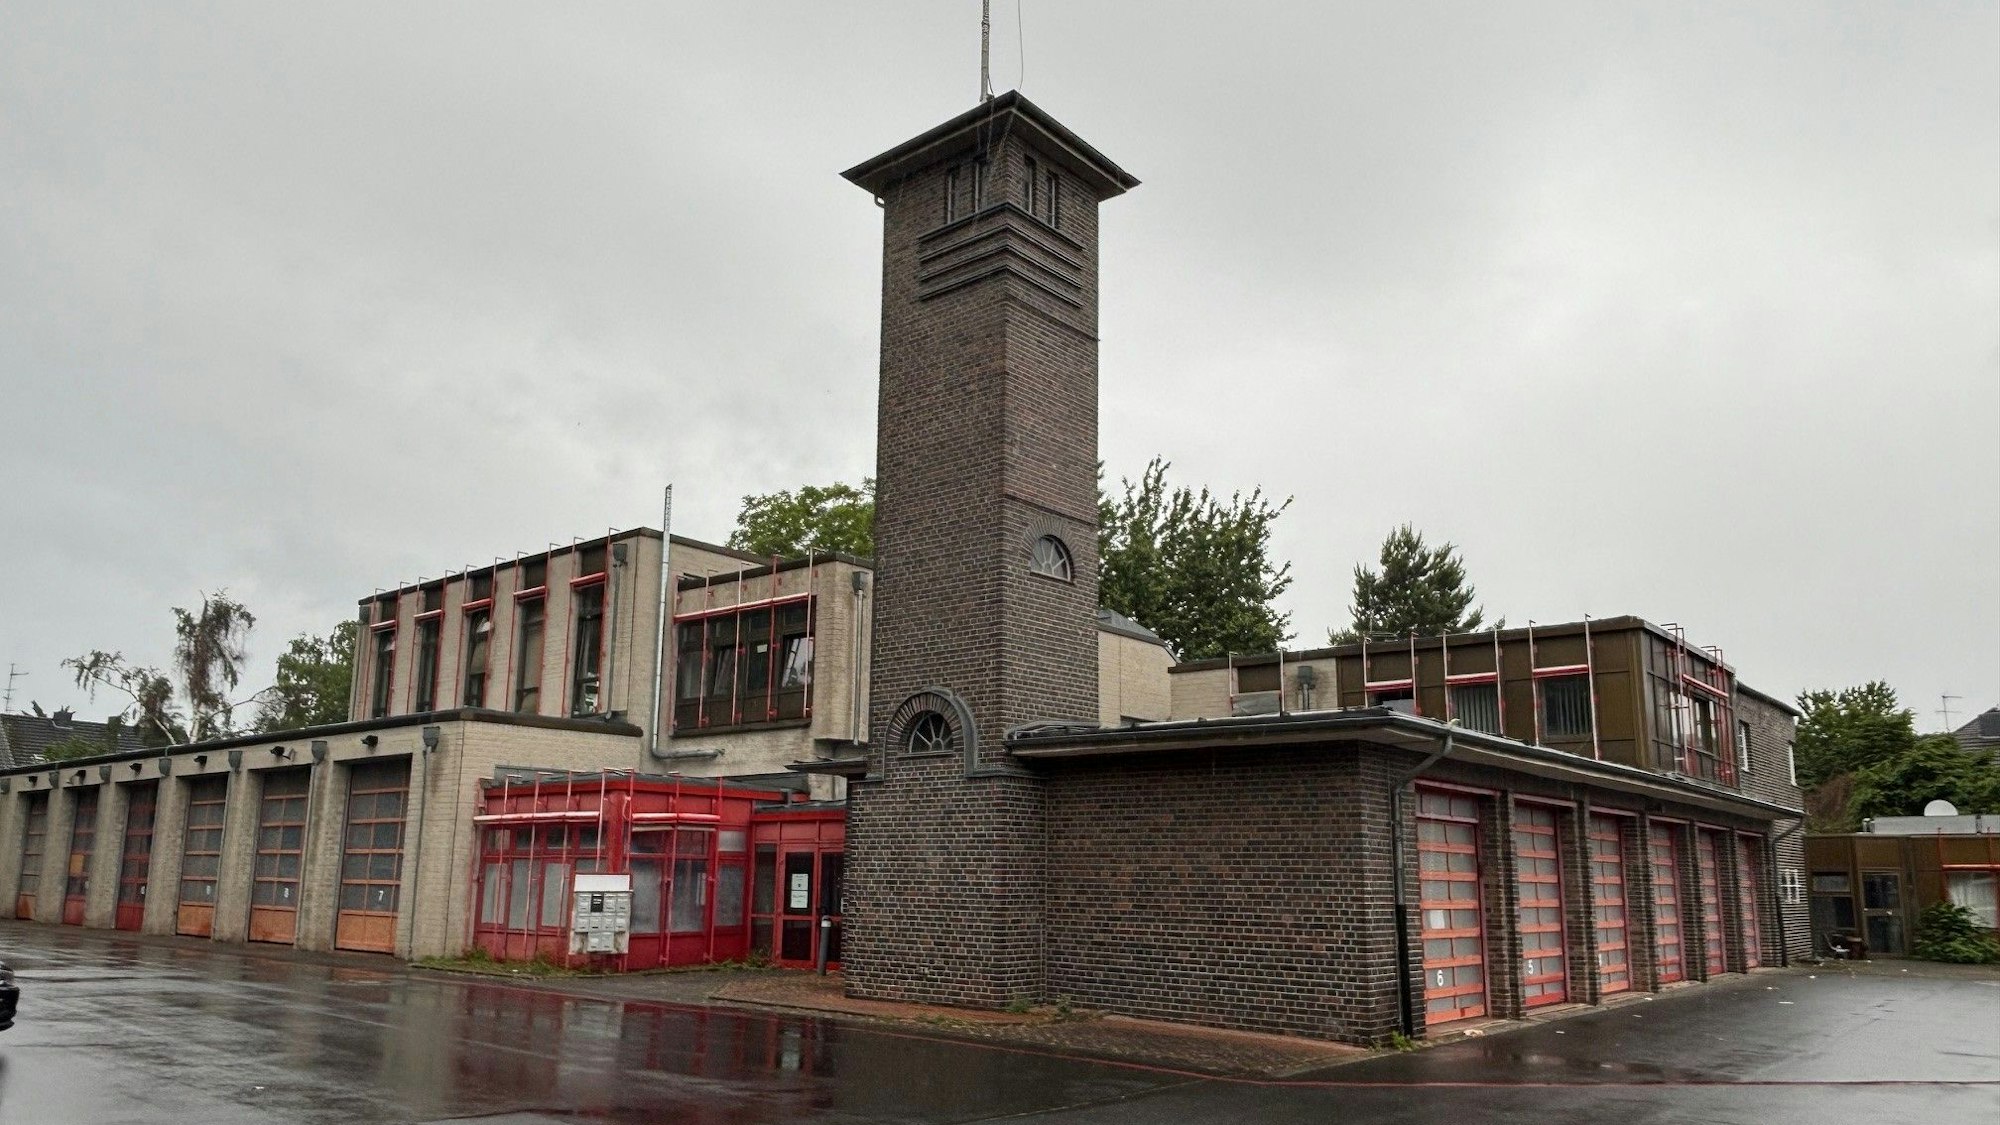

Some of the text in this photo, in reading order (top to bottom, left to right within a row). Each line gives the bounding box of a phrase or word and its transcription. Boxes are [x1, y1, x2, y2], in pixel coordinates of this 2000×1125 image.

[378, 890, 384, 901] 7
[1528, 959, 1534, 975] 5
[1437, 969, 1444, 986] 6
